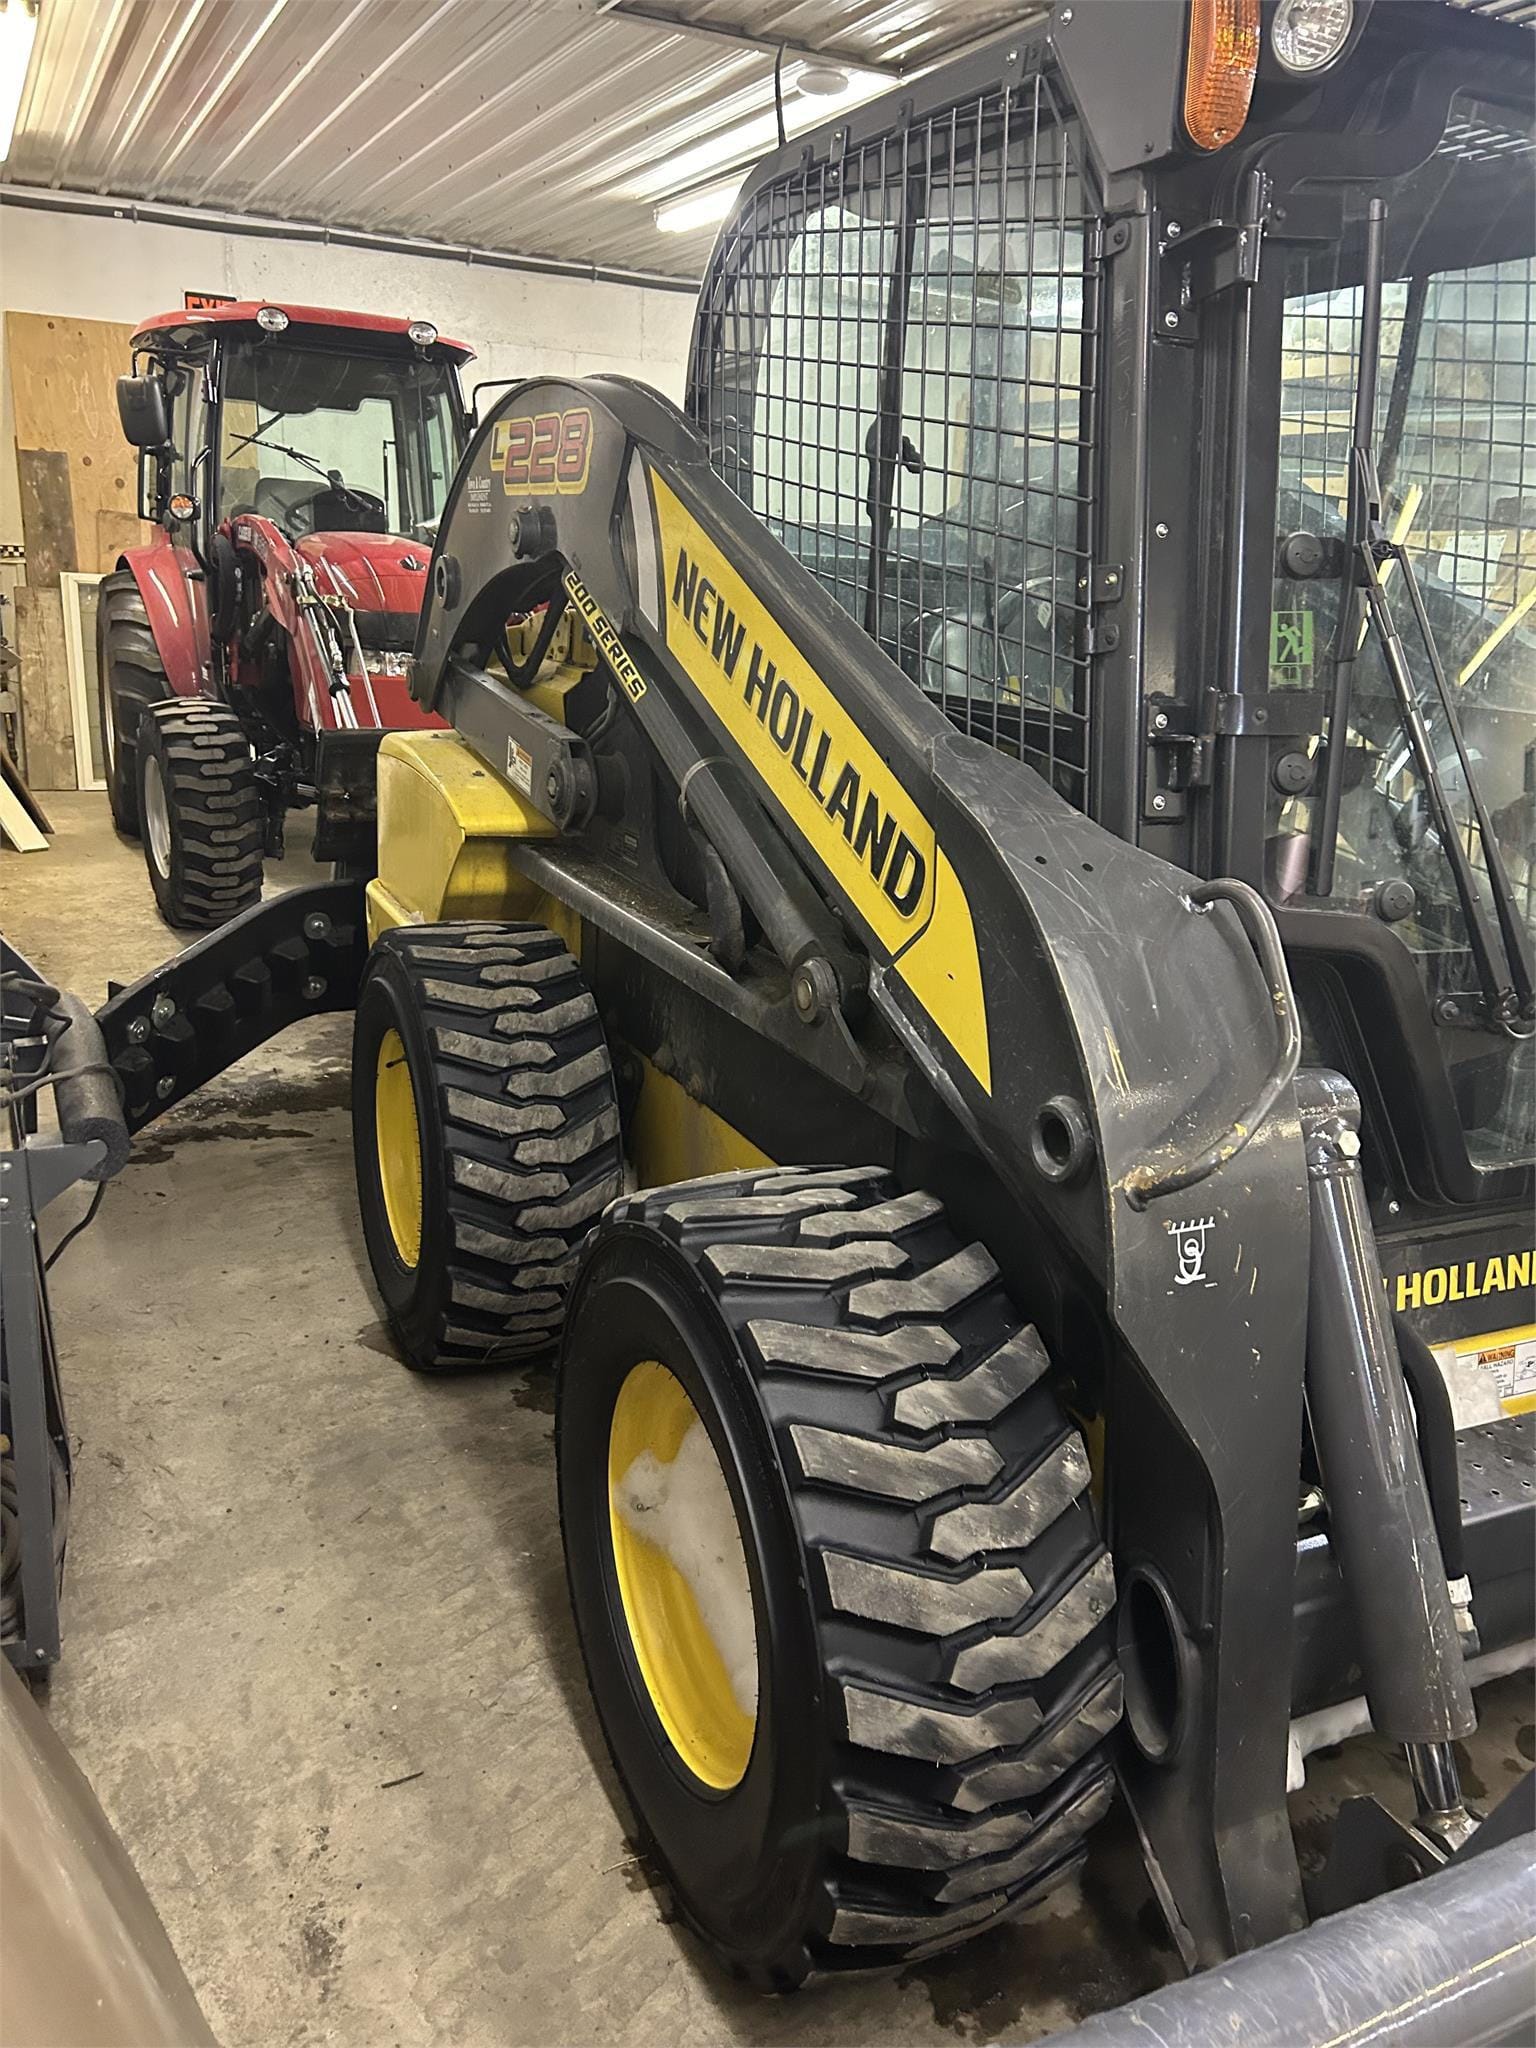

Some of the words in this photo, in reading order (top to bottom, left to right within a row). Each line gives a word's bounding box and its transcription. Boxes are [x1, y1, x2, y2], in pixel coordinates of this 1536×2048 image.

[491, 409, 592, 495] L228
[566, 573, 596, 615] 200
[593, 616, 646, 698] SERIES
[672, 548, 746, 678] NEW
[744, 644, 926, 917] HOLLAND
[1396, 1250, 1536, 1312] HOLLAN
